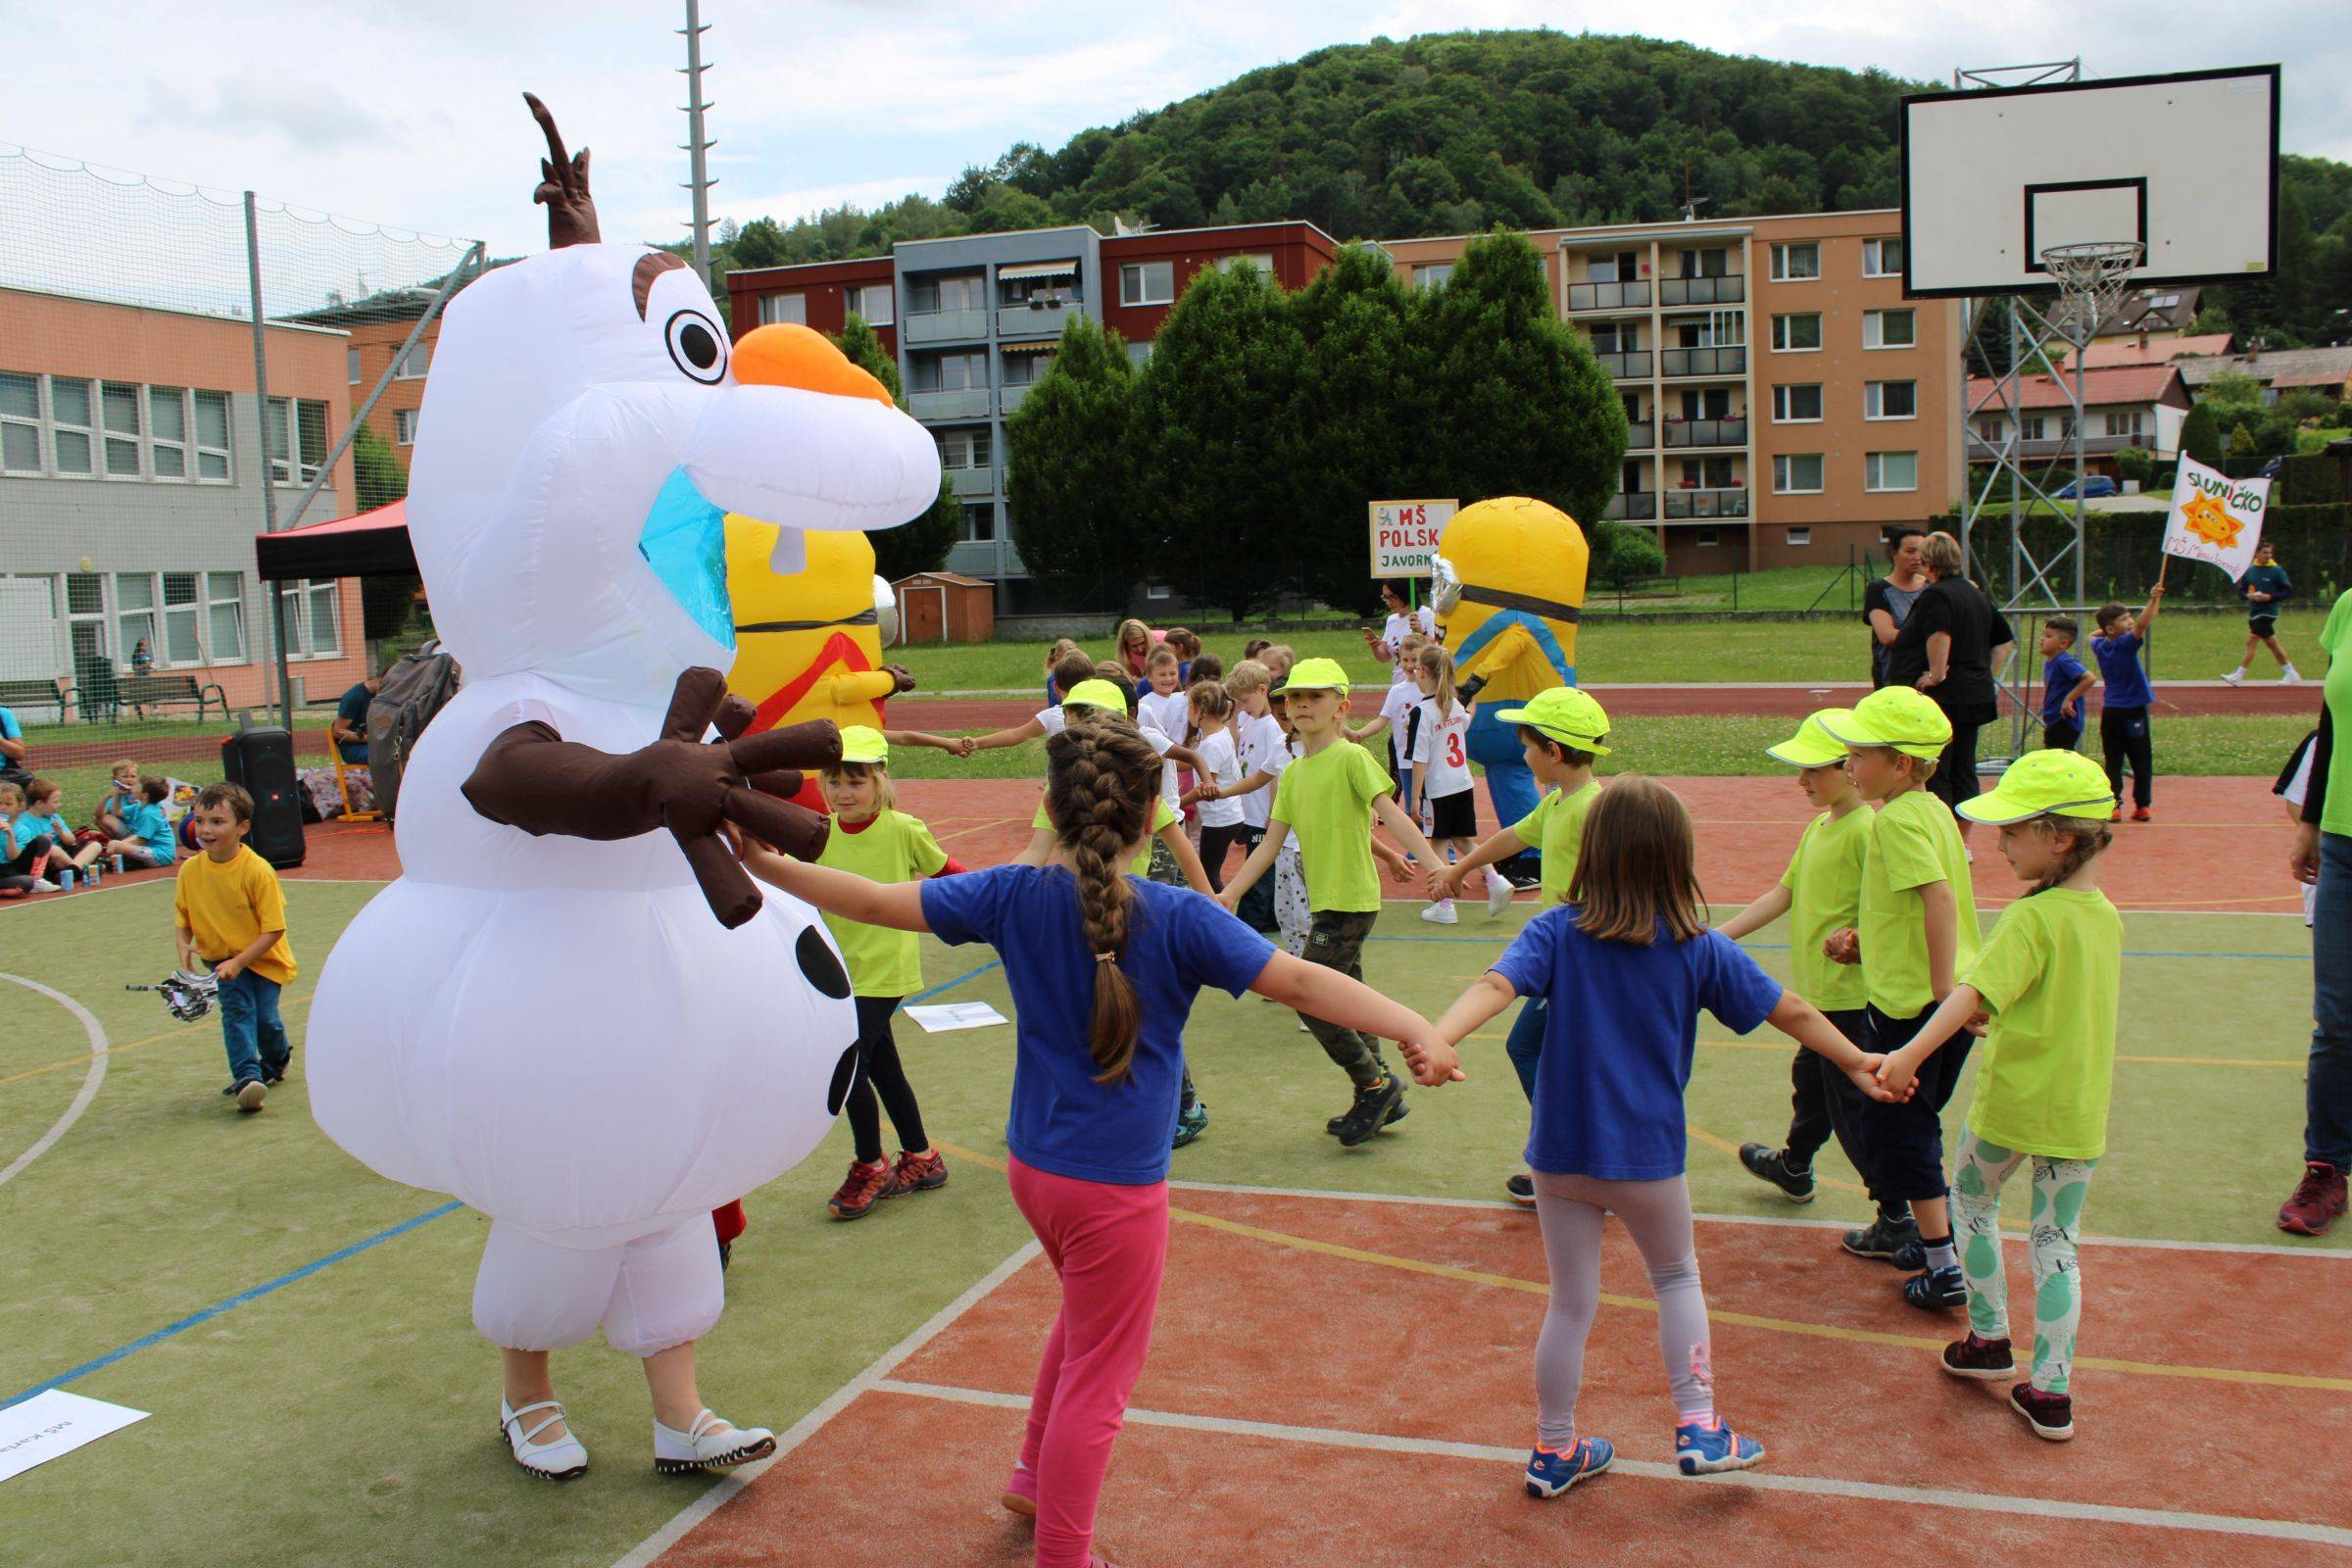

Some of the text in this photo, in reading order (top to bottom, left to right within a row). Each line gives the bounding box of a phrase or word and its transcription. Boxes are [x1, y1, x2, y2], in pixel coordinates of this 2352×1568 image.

[2187, 471, 2263, 513] SLUNÍČKO
[1399, 504, 1426, 525] MŠ
[1381, 554, 1433, 566] JAVORN
[1446, 732, 1465, 768] 3
